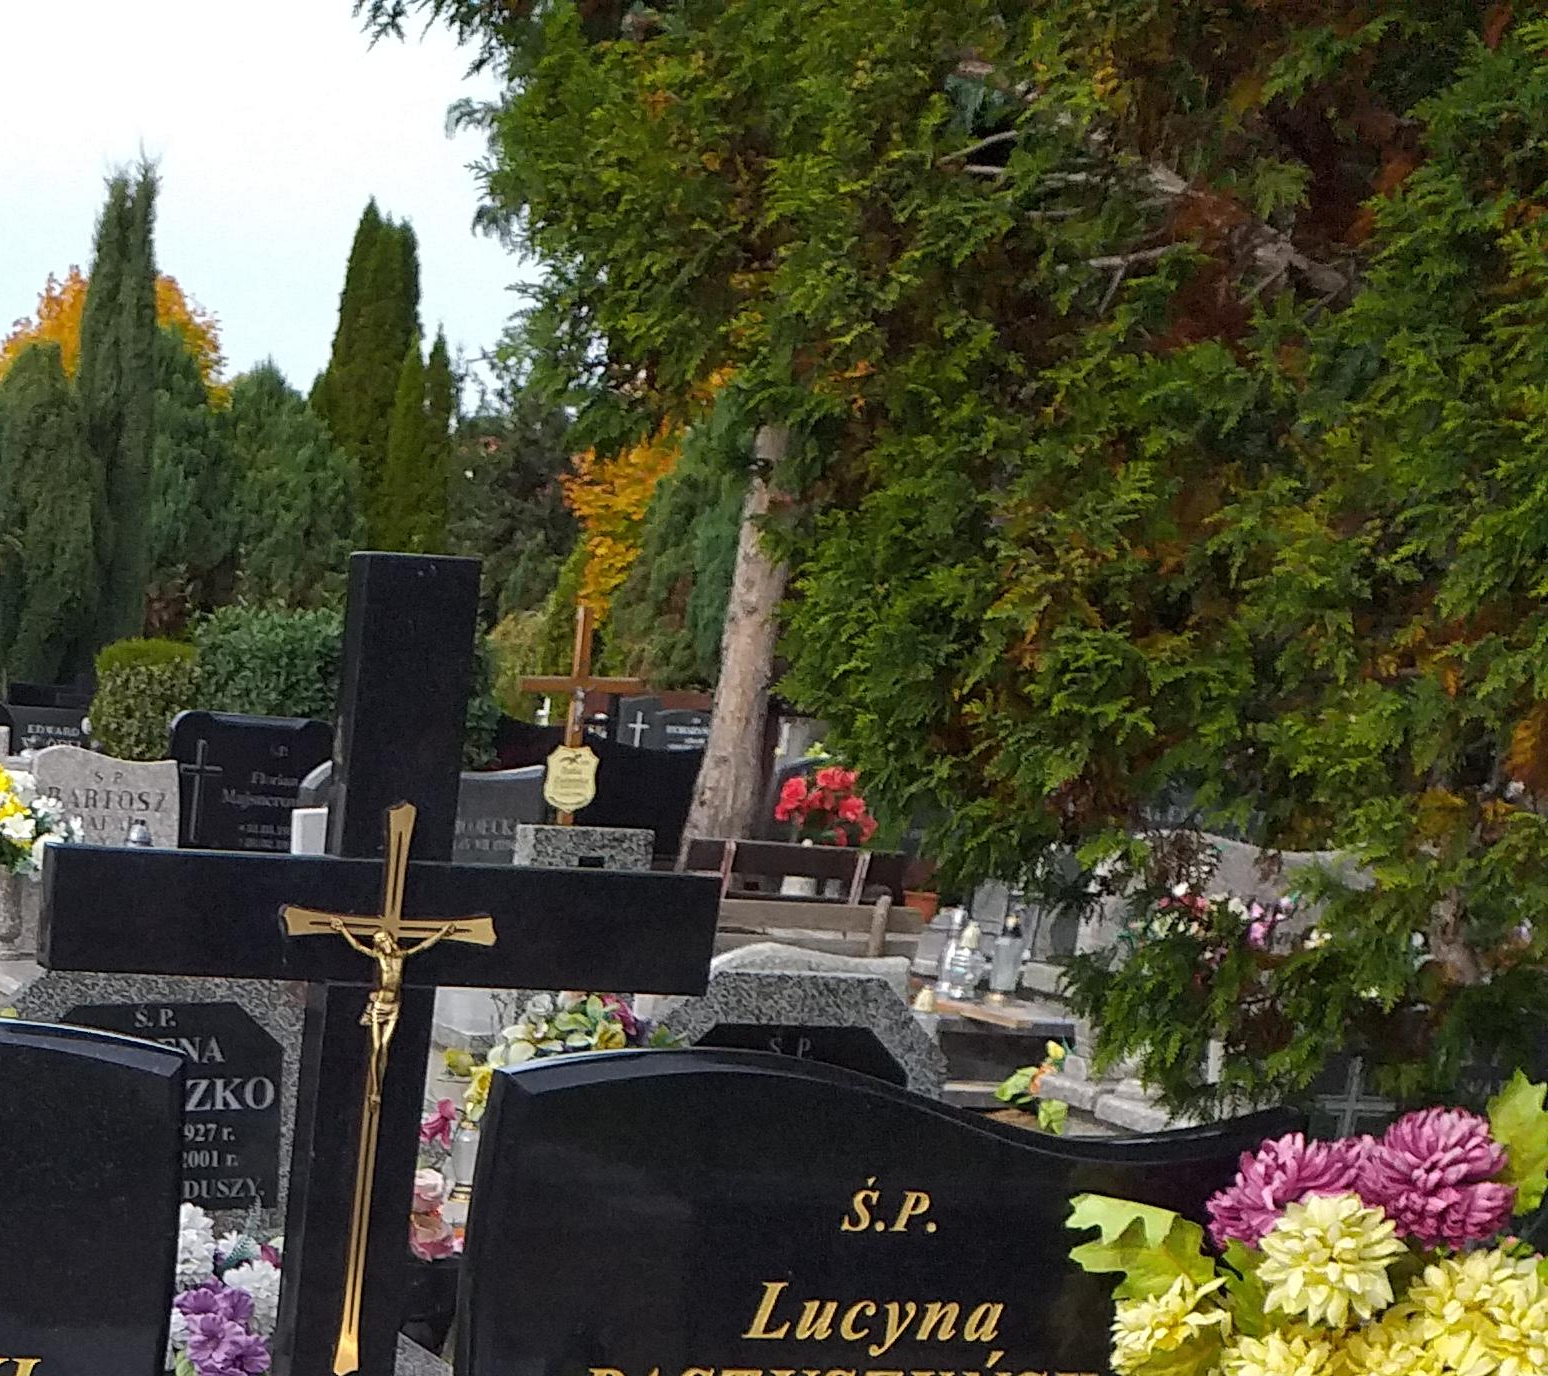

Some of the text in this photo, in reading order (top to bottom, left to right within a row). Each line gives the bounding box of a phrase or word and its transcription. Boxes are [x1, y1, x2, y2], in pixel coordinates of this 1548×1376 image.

[47, 785, 165, 813] BARTOSZ
[840, 1176, 940, 1234] Ś.P.
[740, 1280, 1005, 1357] Lucyna
